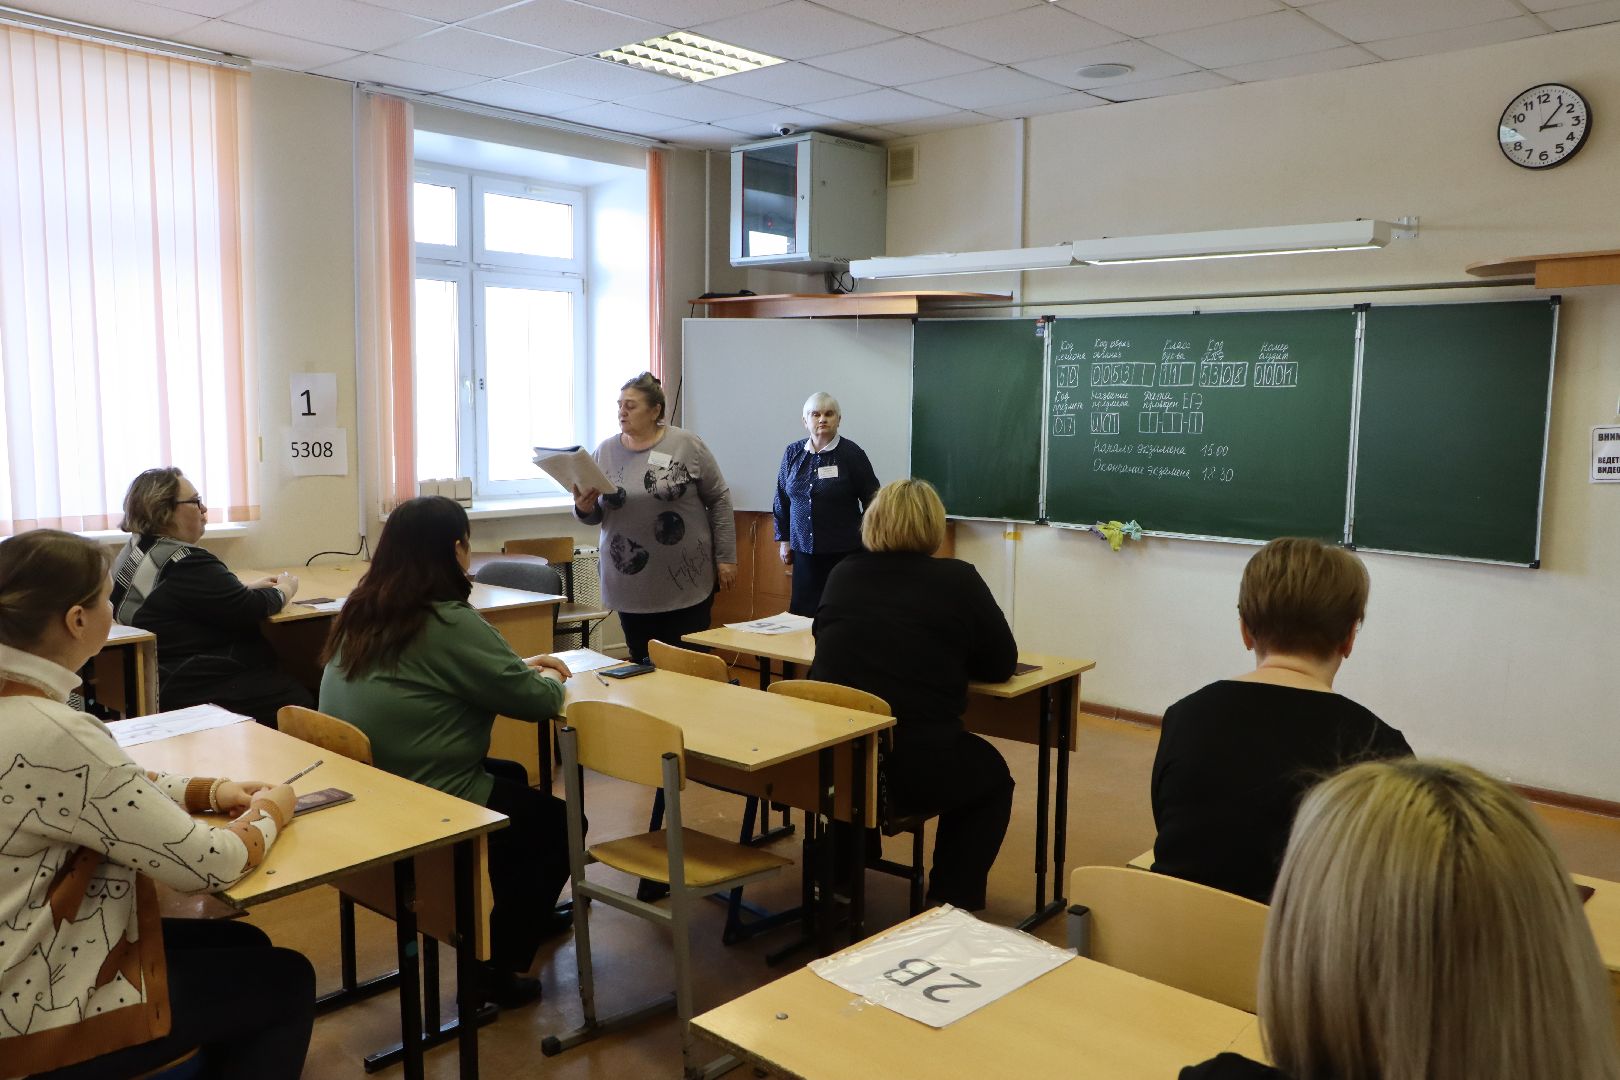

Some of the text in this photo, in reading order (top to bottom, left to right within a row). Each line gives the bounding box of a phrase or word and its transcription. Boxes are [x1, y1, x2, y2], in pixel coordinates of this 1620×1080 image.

[1537, 93, 1550, 104] 12
[1524, 101, 1533, 111] 11
[1566, 103, 1575, 114] 2
[1512, 113, 1525, 123] 10
[1571, 115, 1581, 126] 3
[1566, 132, 1575, 141] 4
[1513, 142, 1522, 151] 8
[1555, 143, 1564, 154] 5
[1525, 149, 1533, 159] 7
[1538, 151, 1548, 161] 6
[1260, 342, 1289, 352] Номер
[1201, 365, 1244, 385] 5308
[300, 389, 316, 416] 1
[1183, 392, 1204, 410] ЕГЭ
[291, 441, 333, 458] 5308
[1092, 439, 1134, 455] Начало
